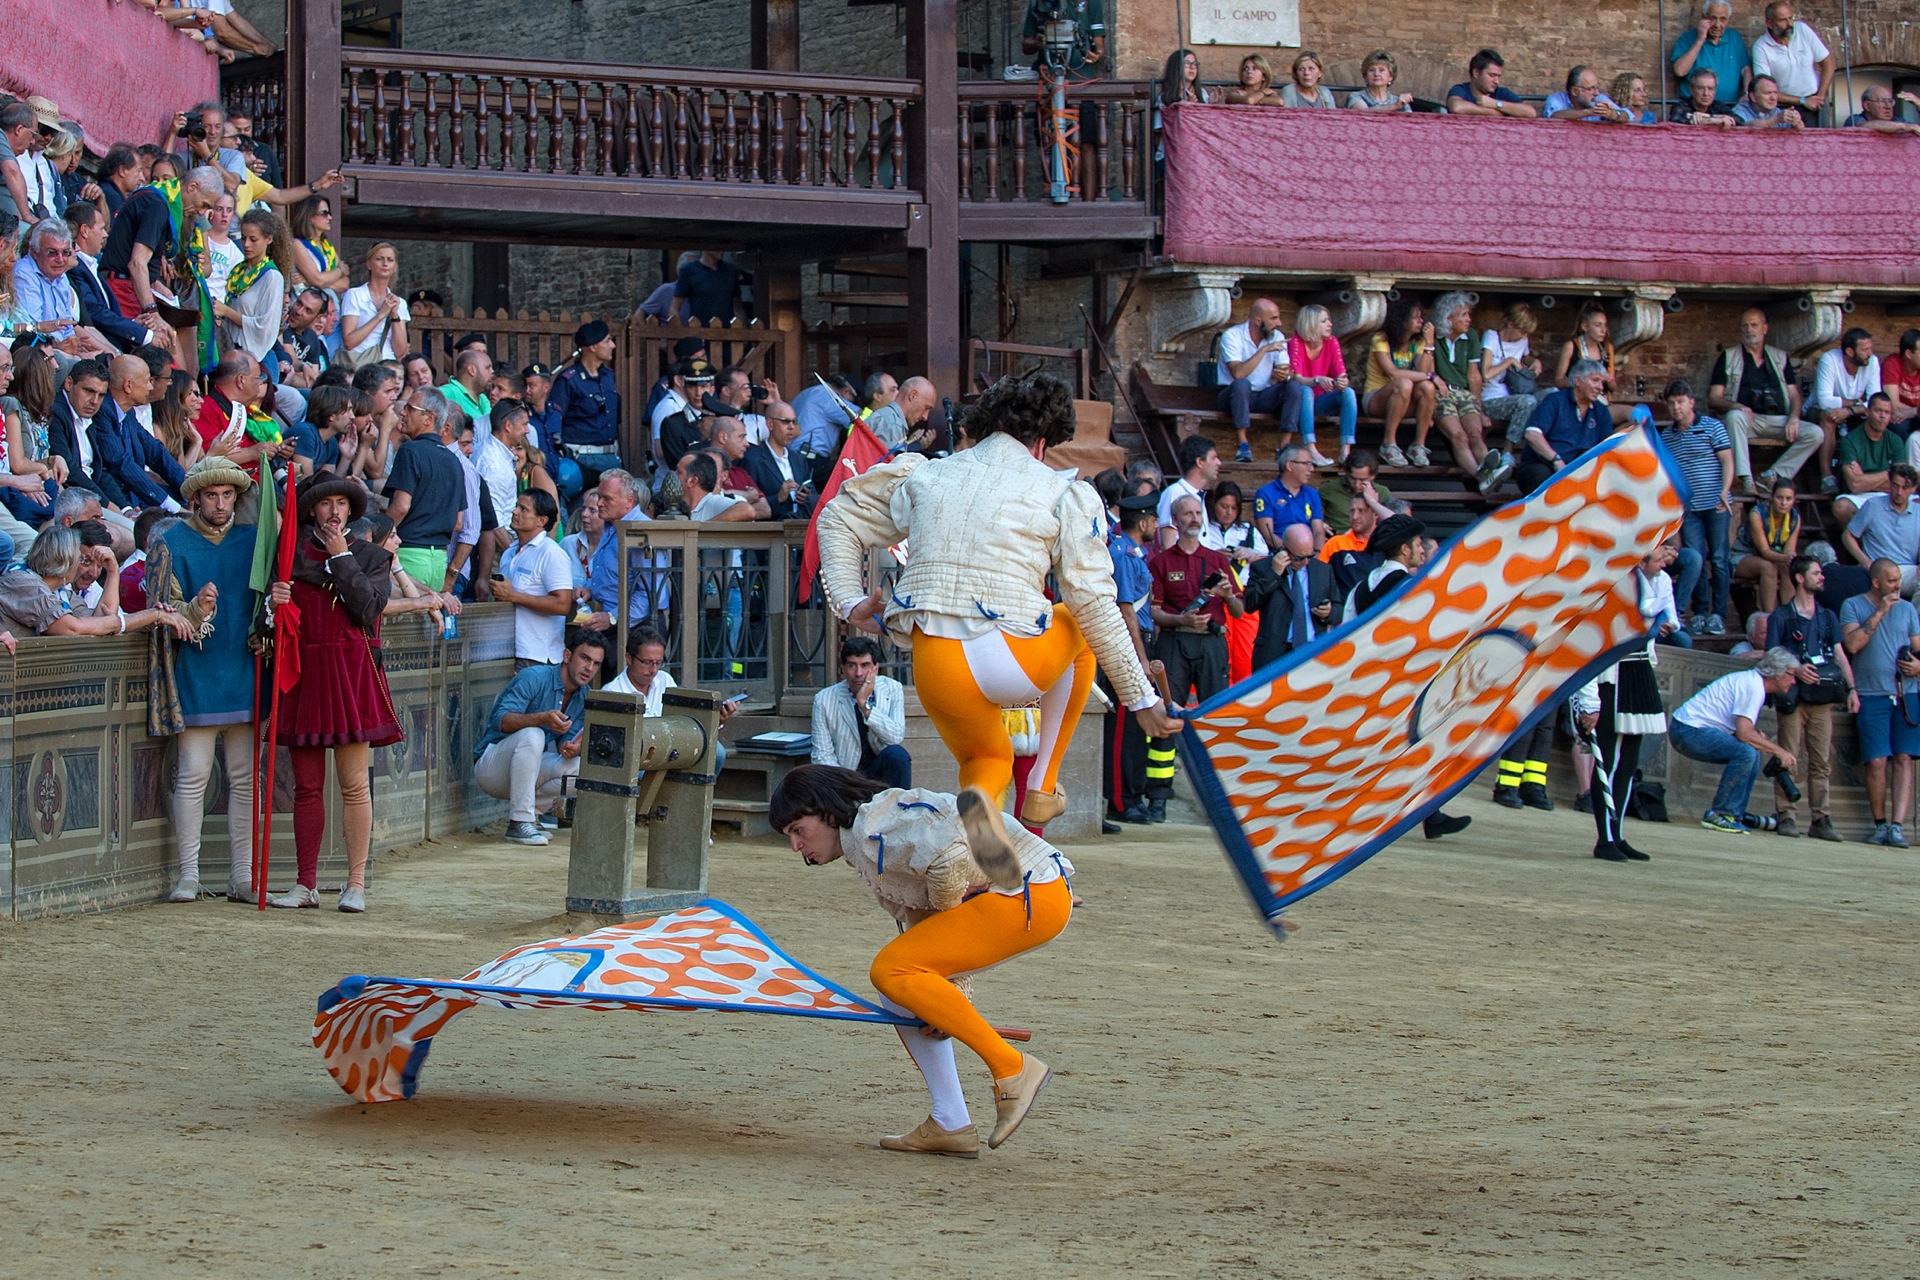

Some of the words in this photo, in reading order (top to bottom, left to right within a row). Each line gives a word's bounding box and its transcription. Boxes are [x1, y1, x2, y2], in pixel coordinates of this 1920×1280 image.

[1214, 9, 1226, 20] IL
[1232, 9, 1277, 21] CAMPO
[1256, 498, 1265, 512] 3
